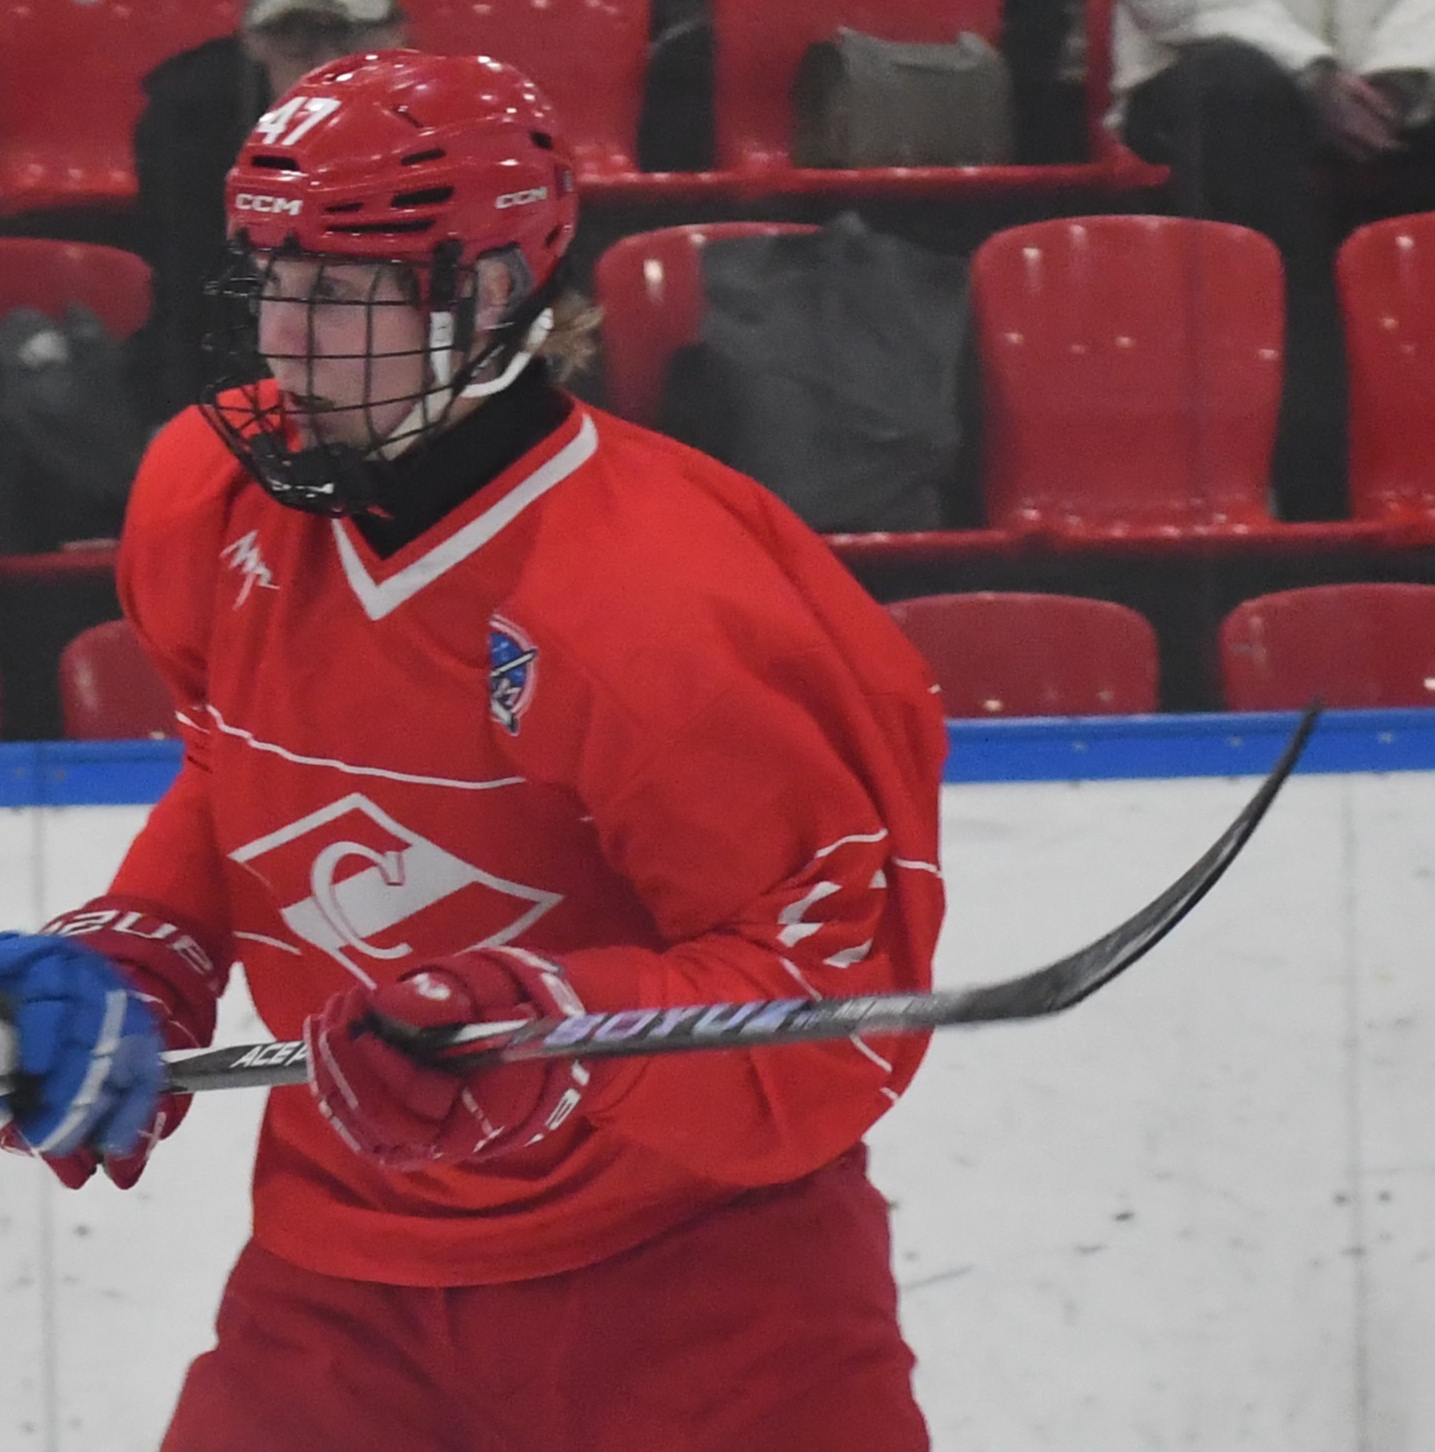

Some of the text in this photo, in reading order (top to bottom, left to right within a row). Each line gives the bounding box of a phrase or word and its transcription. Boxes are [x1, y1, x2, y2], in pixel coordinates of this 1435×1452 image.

[257, 96, 342, 146] 47
[235, 193, 304, 216] CCM
[495, 186, 548, 209] CCM
